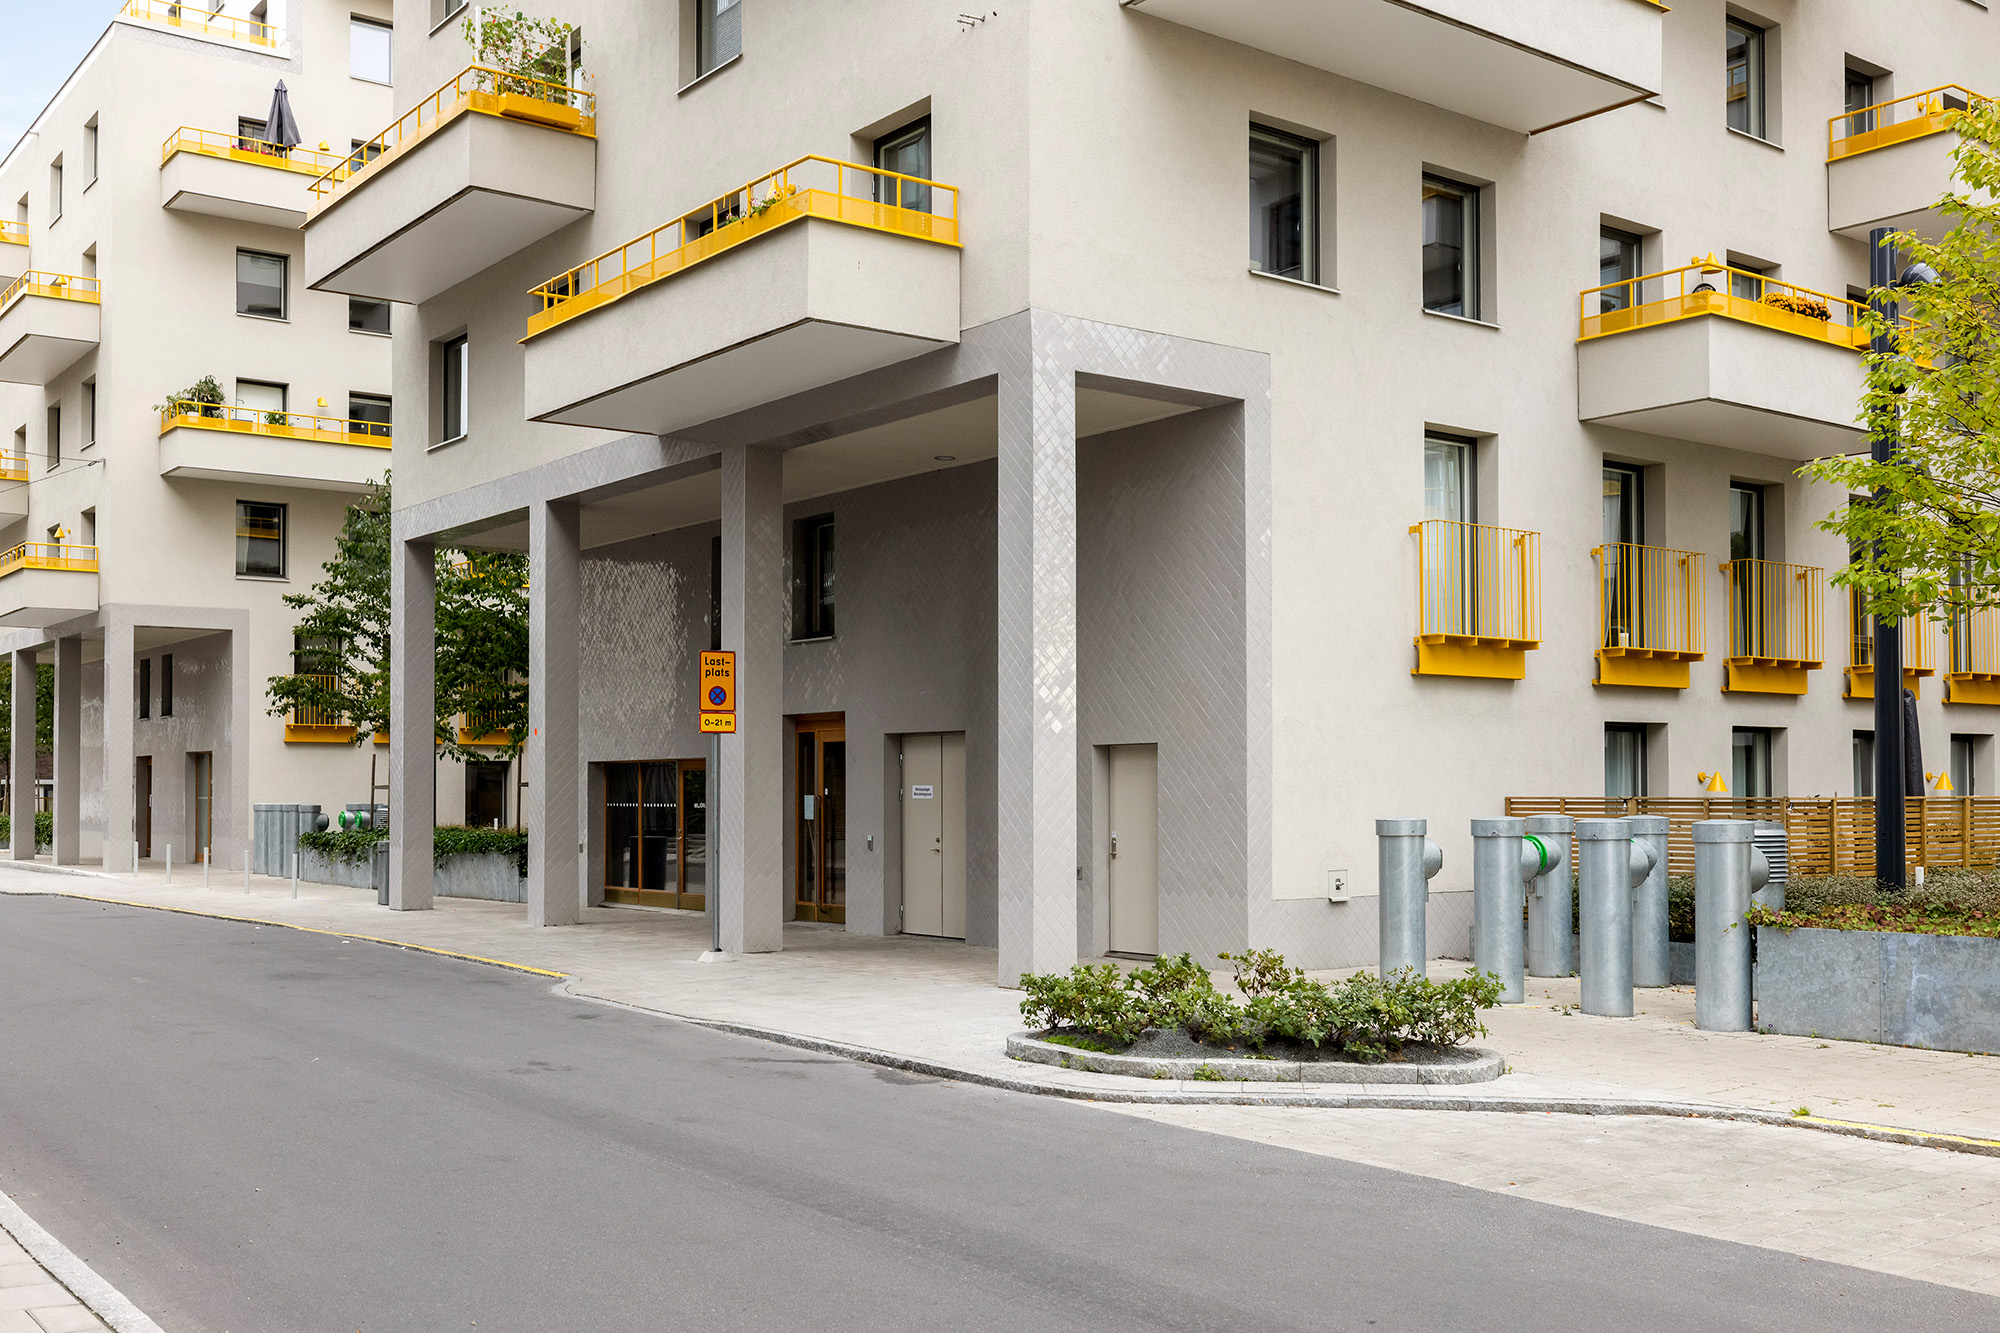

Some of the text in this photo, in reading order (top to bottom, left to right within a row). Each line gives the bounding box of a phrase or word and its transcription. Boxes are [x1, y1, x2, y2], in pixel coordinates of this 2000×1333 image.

[704, 656, 731, 666] Last-
[705, 668, 730, 678] plats
[704, 718, 723, 726] 0-21
